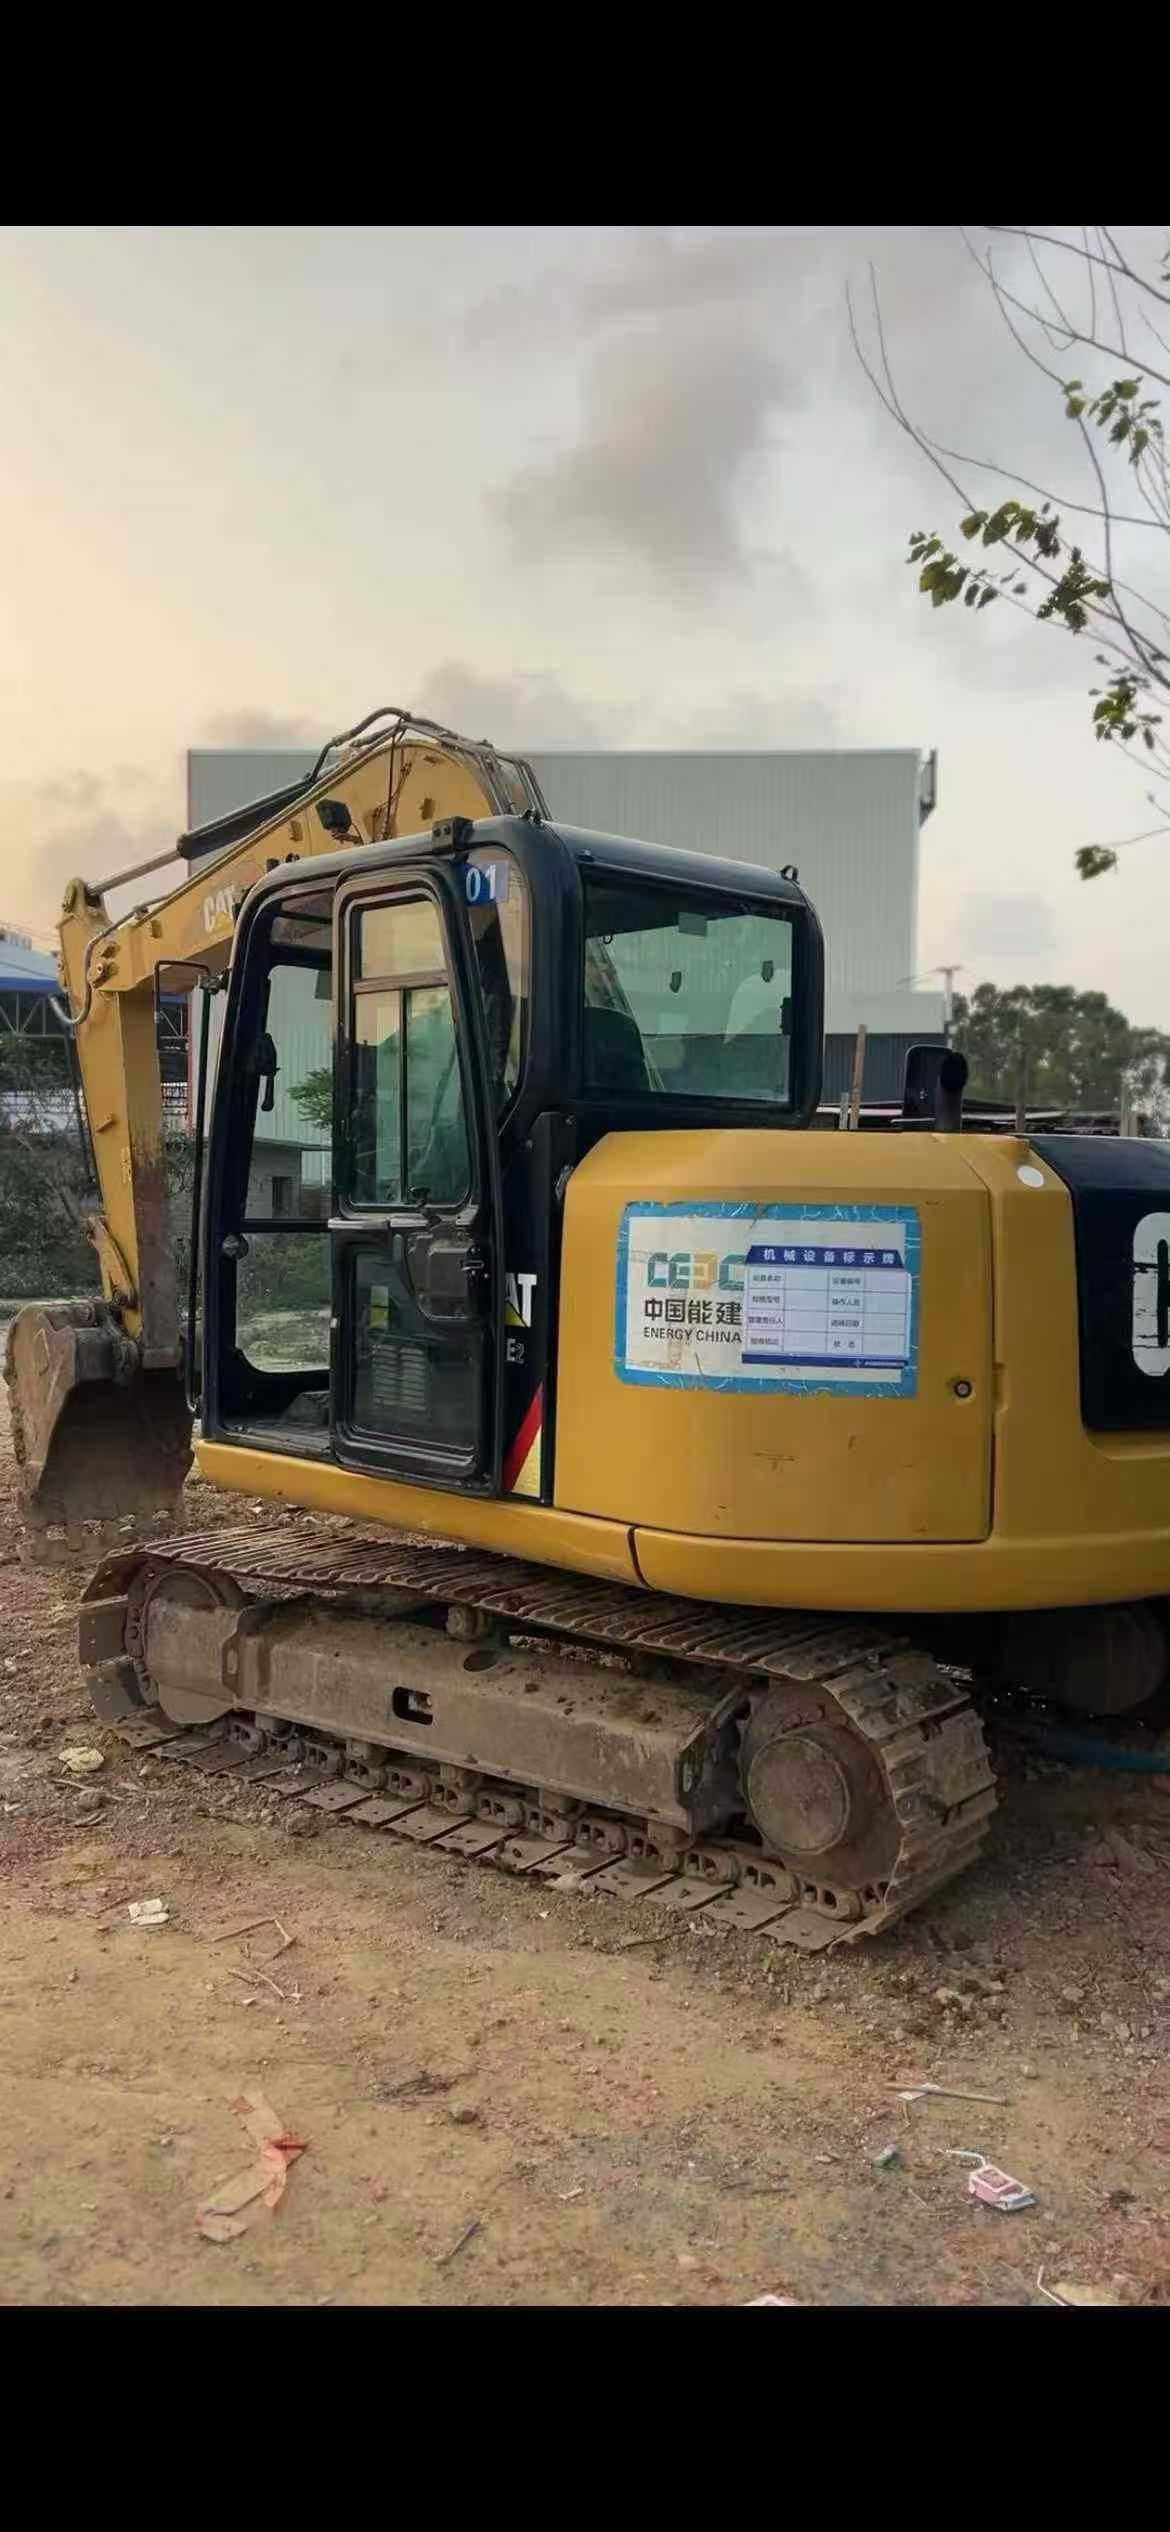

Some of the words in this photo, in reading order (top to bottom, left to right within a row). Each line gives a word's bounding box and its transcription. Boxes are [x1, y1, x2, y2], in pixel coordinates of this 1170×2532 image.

[466, 865, 496, 902] 01
[644, 1298, 743, 1326] 中国能建
[643, 1326, 693, 1341] ENERGY
[696, 1328, 743, 1344] CHINA
